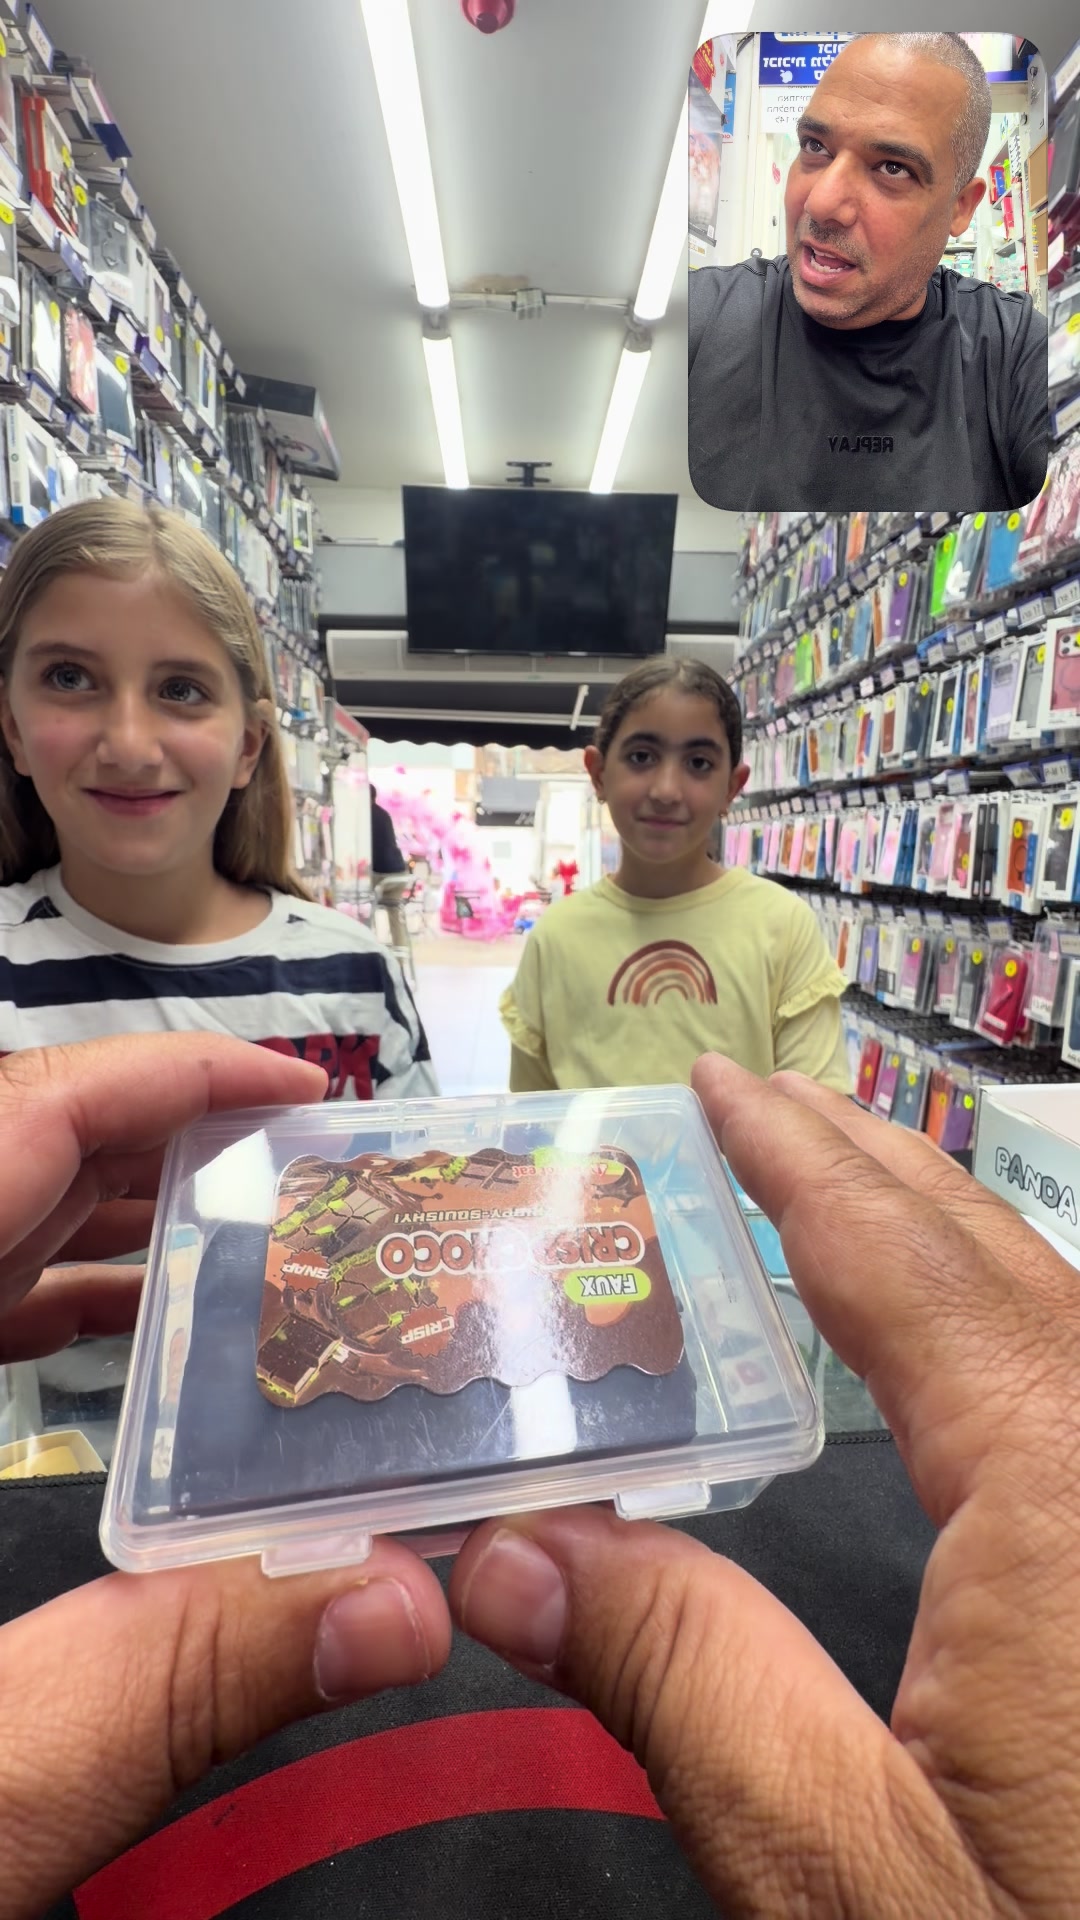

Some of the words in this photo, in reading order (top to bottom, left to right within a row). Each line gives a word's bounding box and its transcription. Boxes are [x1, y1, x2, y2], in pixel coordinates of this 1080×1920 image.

[995, 1146, 1078, 1226] PANDA
[281, 1261, 331, 1281] SNAP
[577, 1272, 638, 1297] FAUX
[400, 1315, 455, 1345] CRISP
